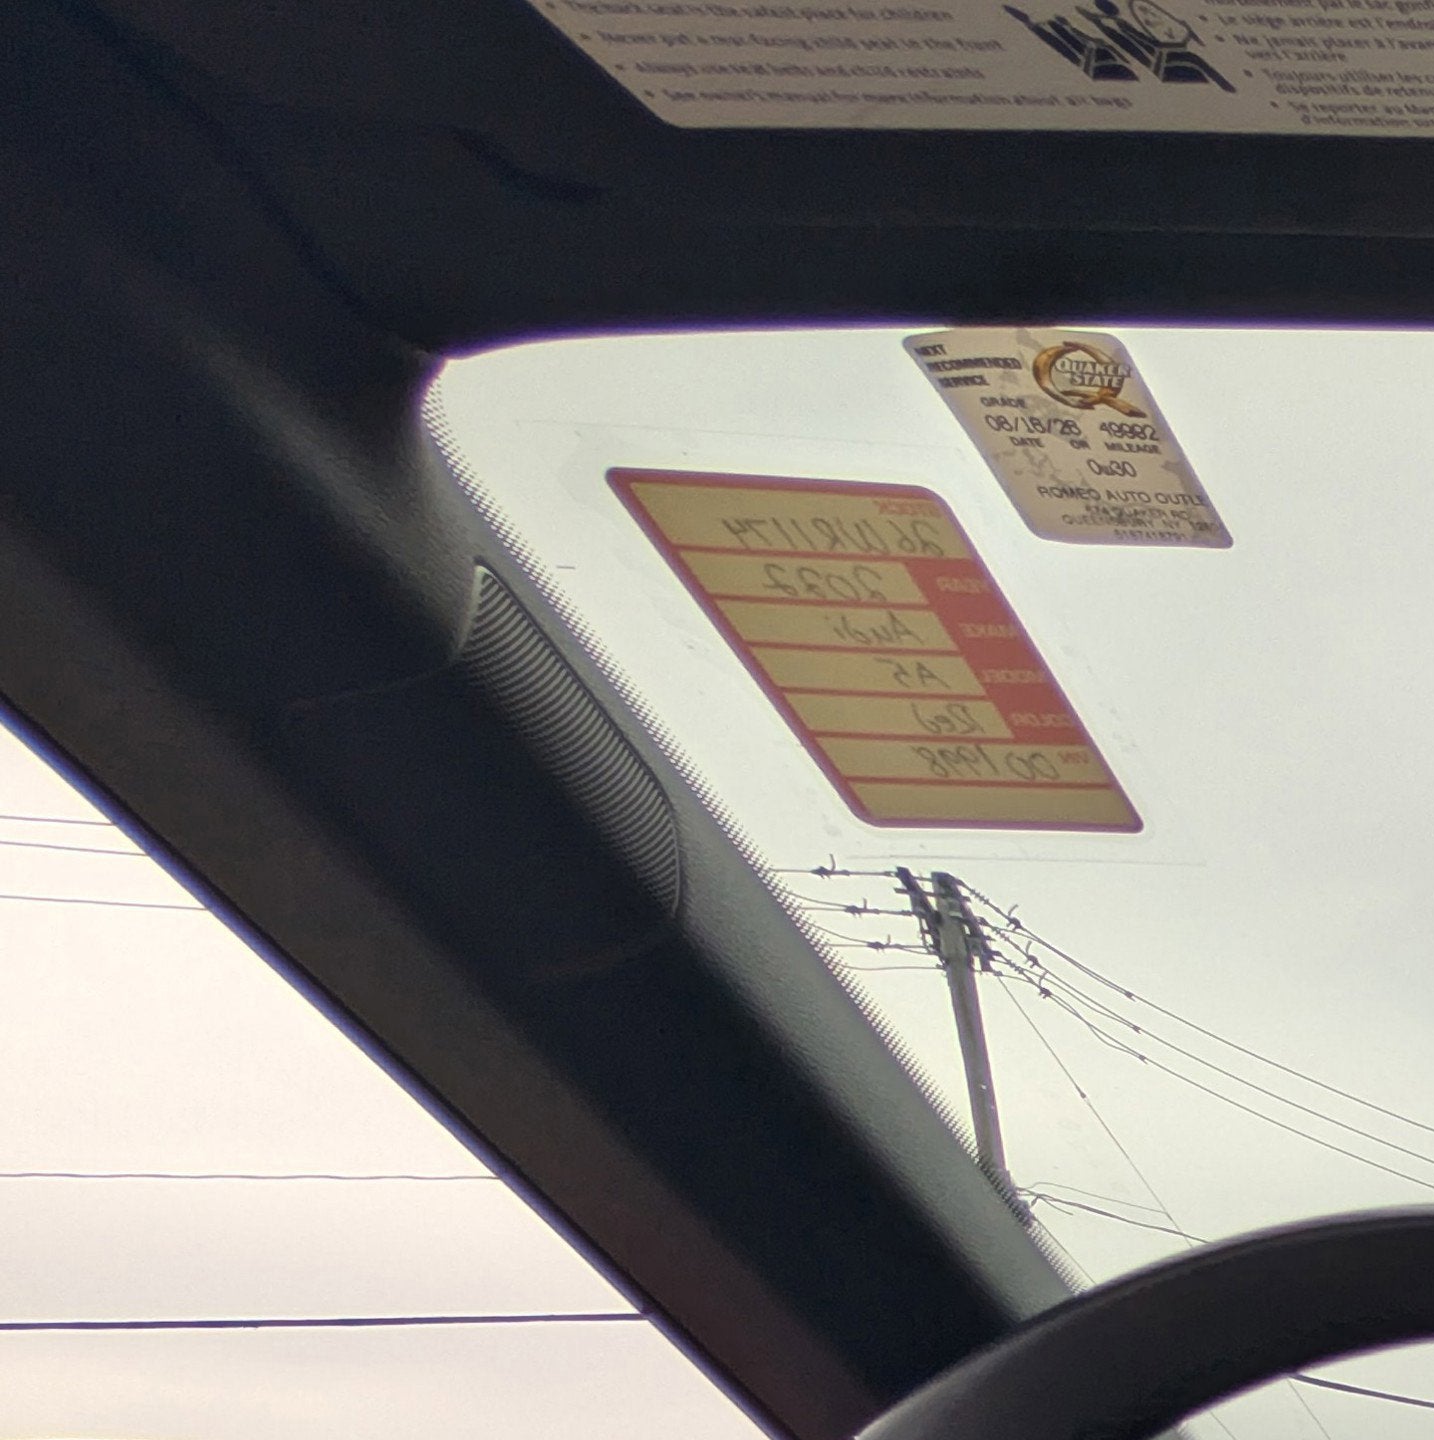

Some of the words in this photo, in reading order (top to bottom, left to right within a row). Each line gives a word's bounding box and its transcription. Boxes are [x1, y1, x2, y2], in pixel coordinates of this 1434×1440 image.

[1054, 357, 1132, 378] QUAKER
[1070, 372, 1124, 387] STATE
[1009, 436, 1045, 448] DATE
[1104, 442, 1161, 454] MILEAGE
[1037, 485, 1101, 501] ROMEO
[1106, 489, 1151, 504] AUTO
